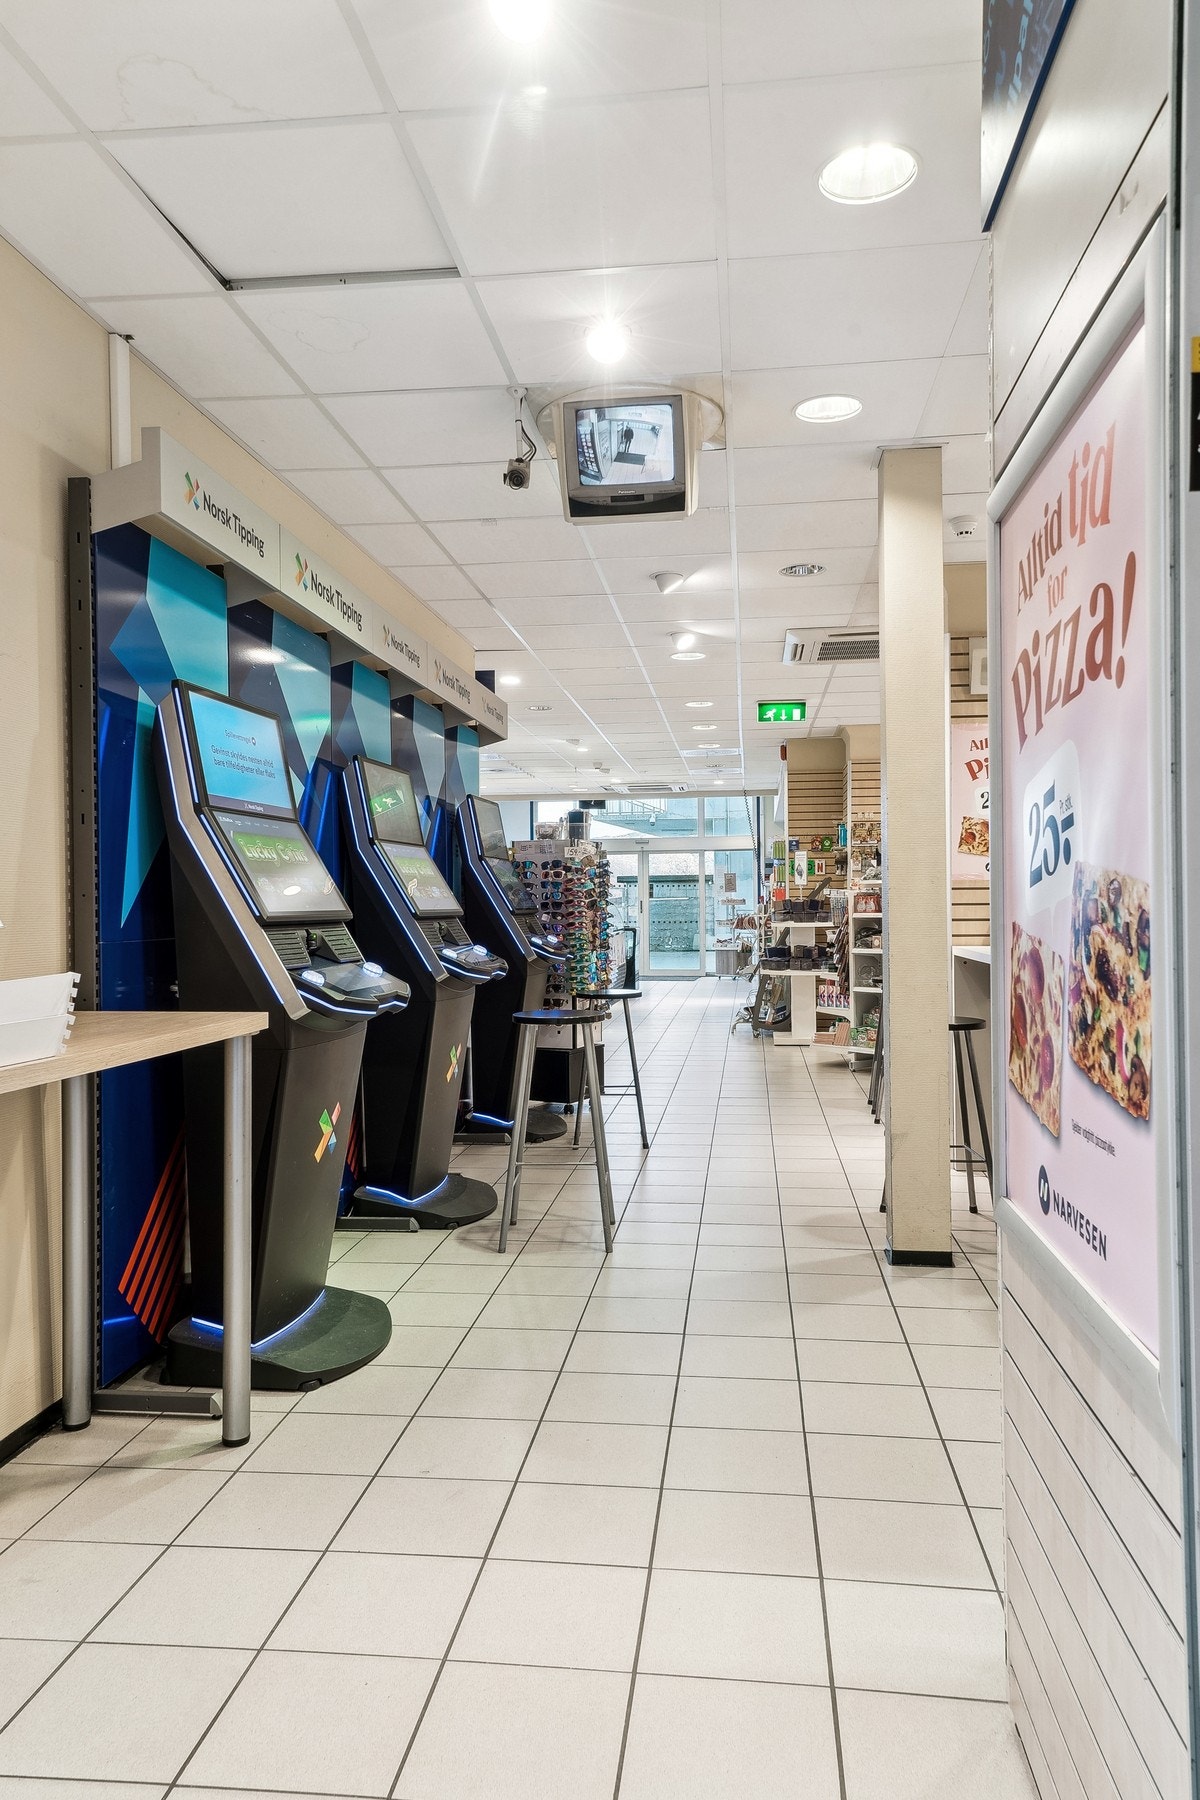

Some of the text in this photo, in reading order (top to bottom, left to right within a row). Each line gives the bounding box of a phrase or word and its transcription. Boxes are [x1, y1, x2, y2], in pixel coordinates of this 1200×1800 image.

[203, 489, 265, 559] Norsk Tipping
[1018, 419, 1116, 616] Alltid tid
[310, 569, 363, 632] Norsk Tipping
[1047, 565, 1068, 617] for
[390, 633, 421, 668] Norsk Tipping
[1011, 551, 1137, 755] Pizza!
[442, 669, 471, 704] Norsk Tipping
[1053, 1189, 1107, 1261] NARVESEN
